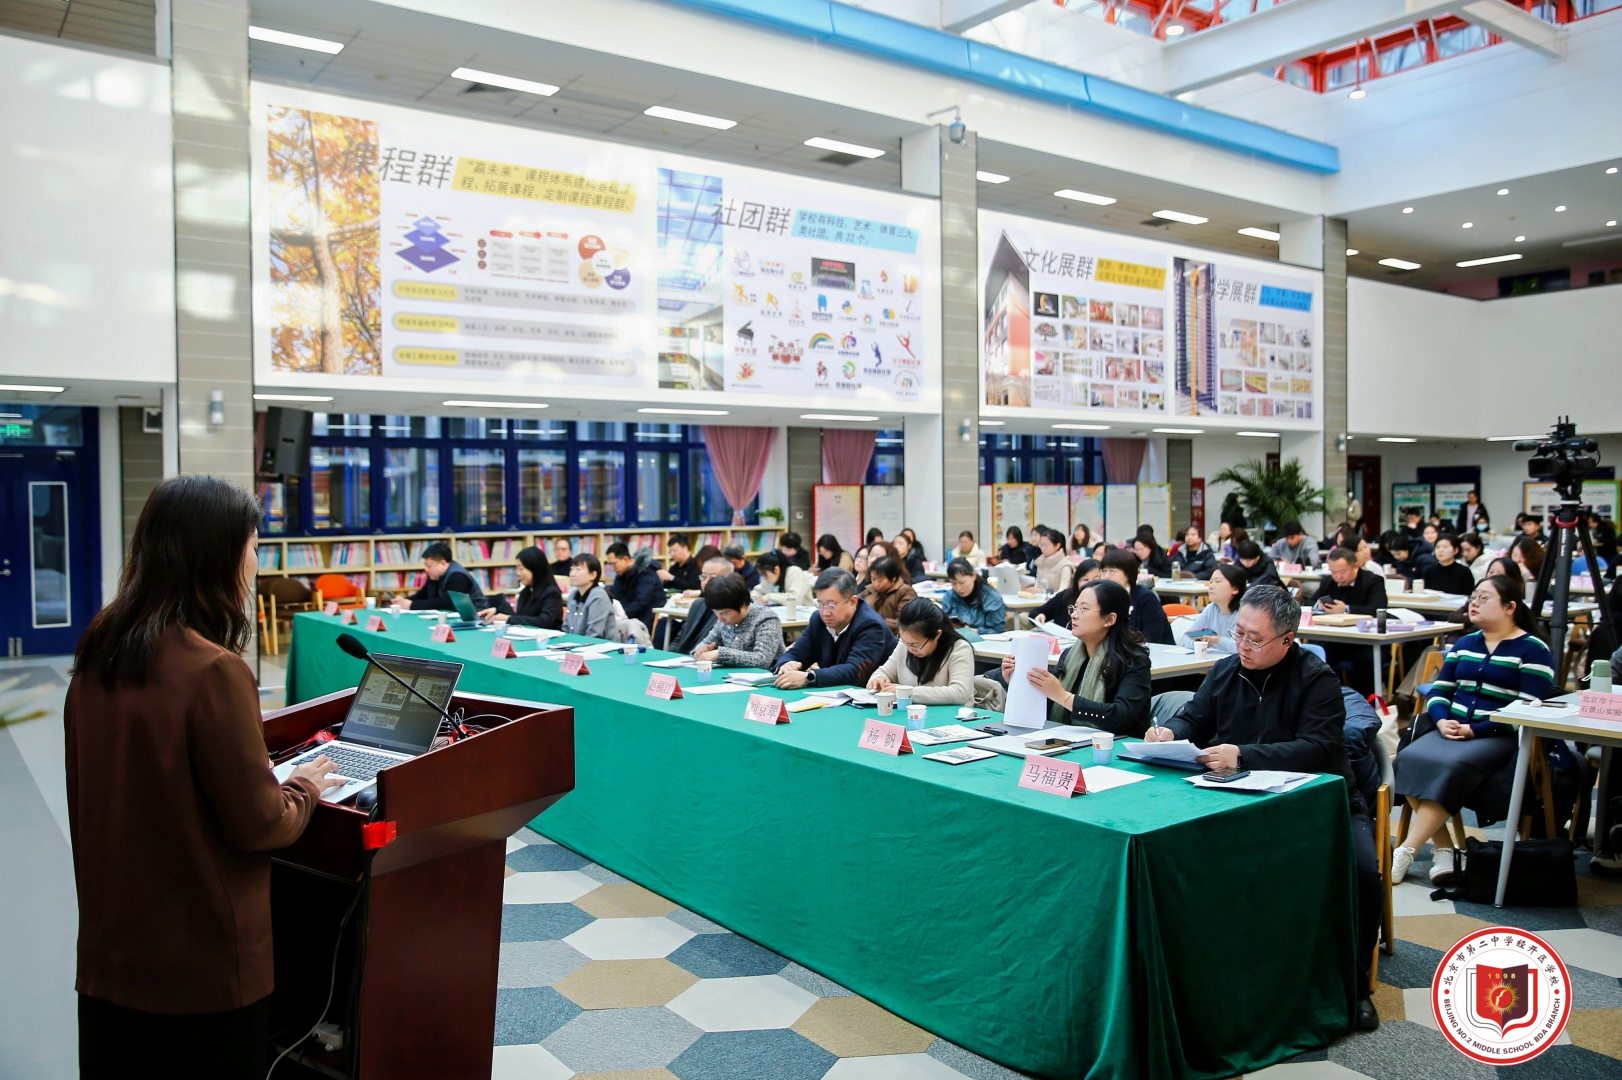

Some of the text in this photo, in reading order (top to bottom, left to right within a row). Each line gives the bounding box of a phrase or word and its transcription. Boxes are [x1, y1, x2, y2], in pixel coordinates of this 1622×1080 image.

[710, 197, 792, 236] 社团群
[1022, 247, 1095, 281] 文化展群
[1203, 276, 1257, 304] 学展群
[1026, 763, 1074, 790] 马福贵
